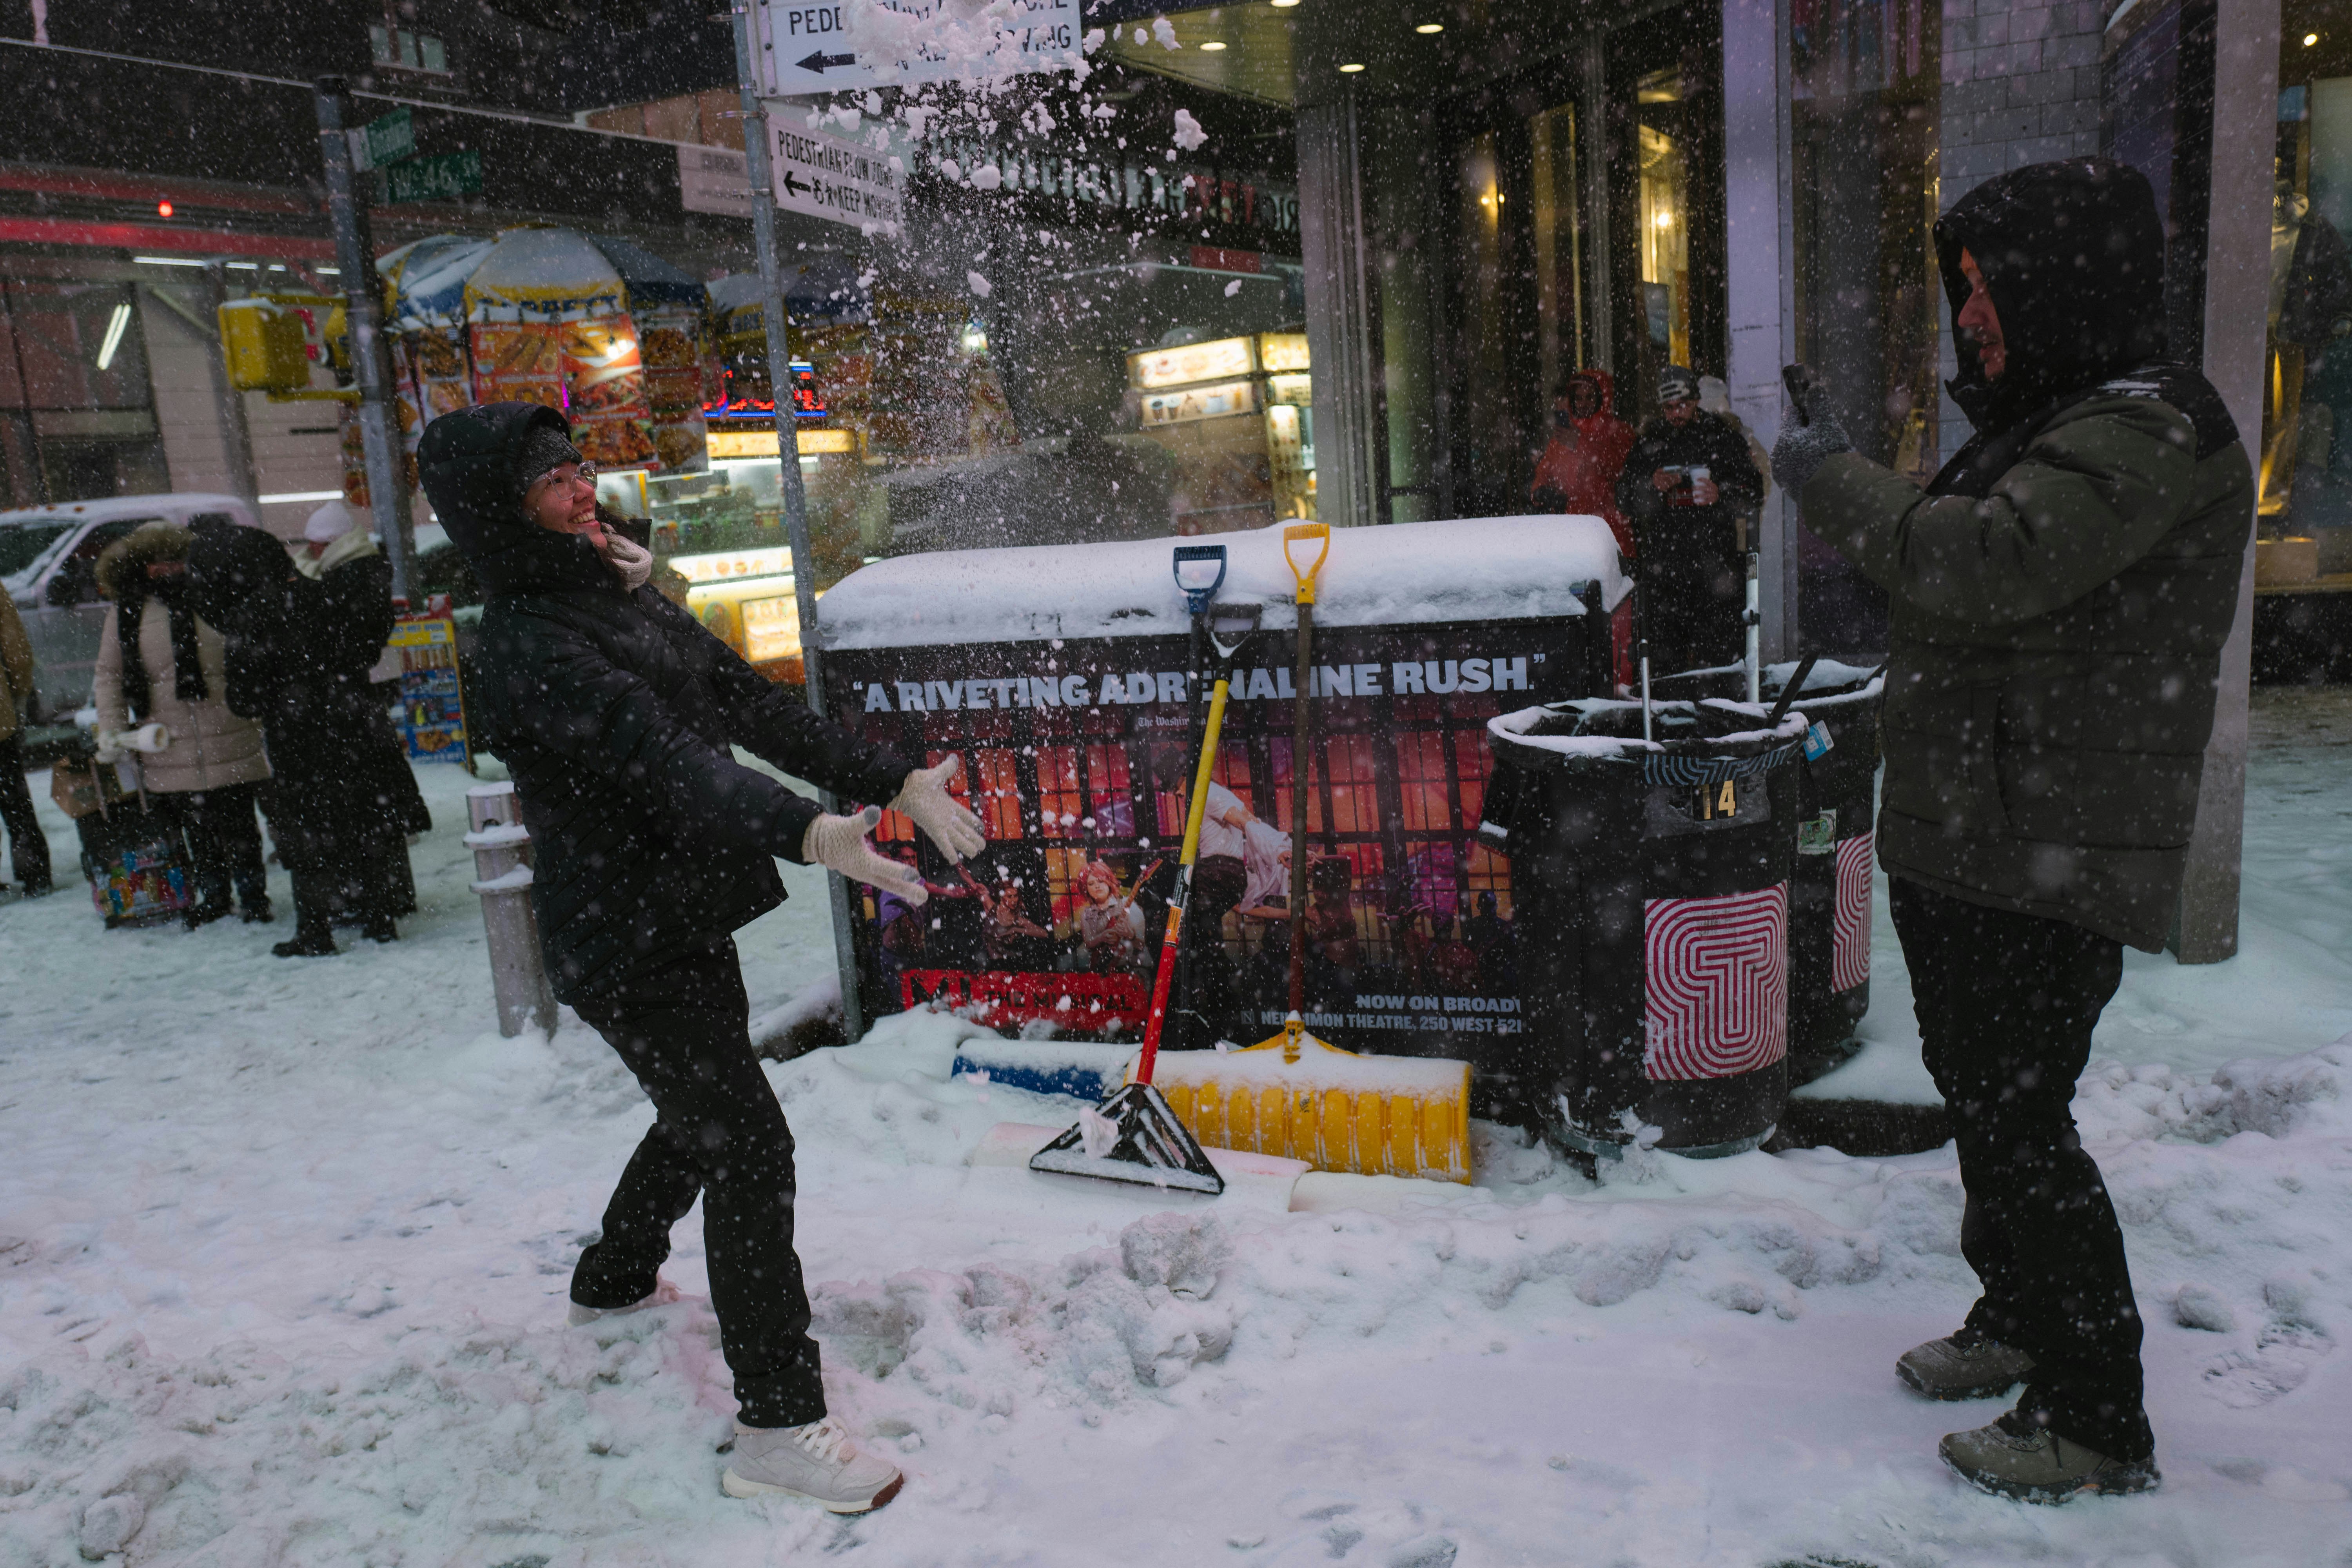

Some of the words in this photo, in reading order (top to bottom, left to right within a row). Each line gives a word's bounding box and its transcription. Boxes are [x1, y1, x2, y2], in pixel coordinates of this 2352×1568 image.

[837, 184, 859, 213] KEEP
[897, 674, 1091, 711] RIVETING
[1138, 717, 1154, 728] The
[1156, 714, 1206, 728] Washinn
[1702, 779, 1736, 820] 14
[984, 990, 1025, 1008] THE
[1356, 995, 1406, 1010] NOW
[1410, 996, 1439, 1011] ON
[1443, 996, 1521, 1013] BROAD
[1302, 1011, 1344, 1028] IMON
[1347, 1013, 1417, 1031] THEATRE,
[1420, 1016, 1448, 1031] 250
[1451, 1017, 1494, 1033] WEST
